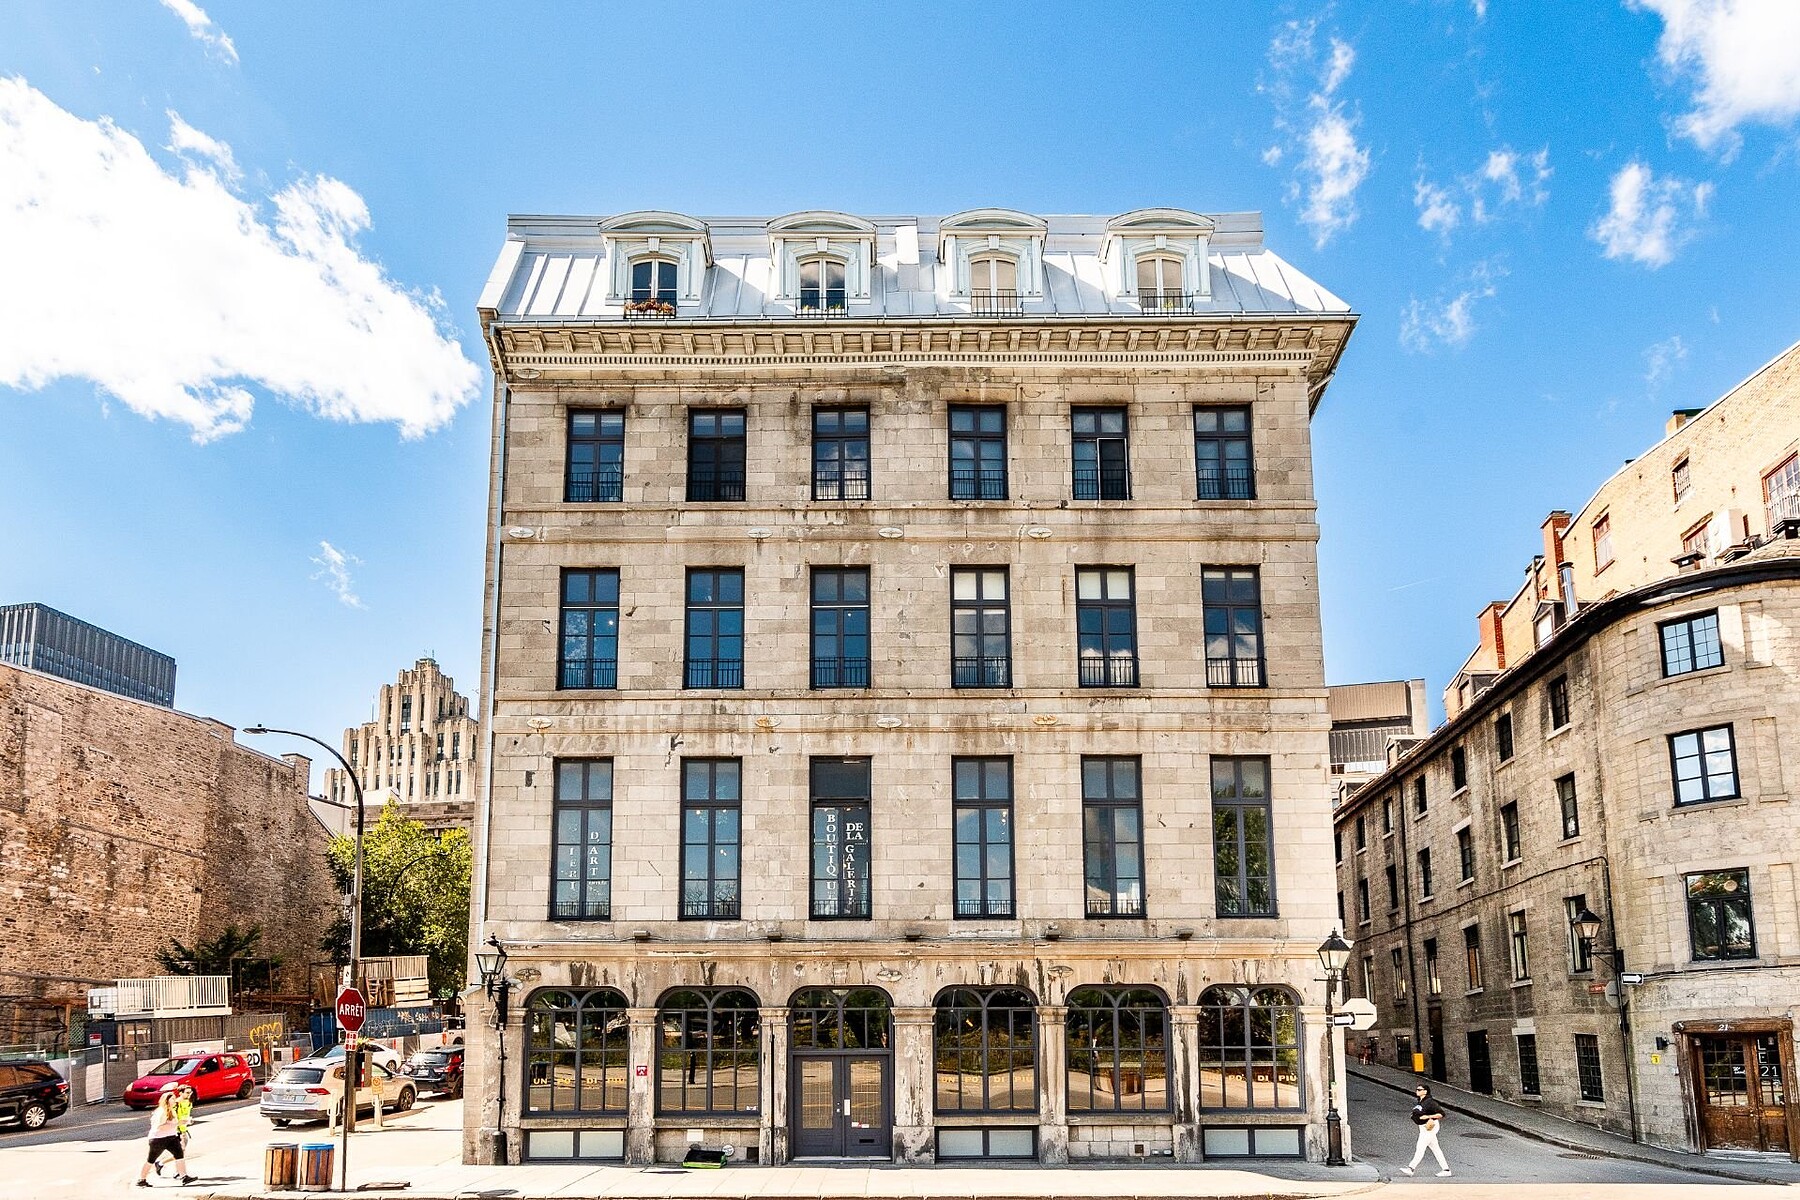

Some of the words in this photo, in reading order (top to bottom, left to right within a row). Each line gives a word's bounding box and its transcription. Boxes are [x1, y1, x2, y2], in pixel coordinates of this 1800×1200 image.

[846, 822, 863, 831] DE
[846, 832, 863, 840] LA
[339, 1002, 364, 1017] ARRÊT
[1760, 1065, 1779, 1077] 21
[1278, 1073, 1297, 1081] PIÙ
